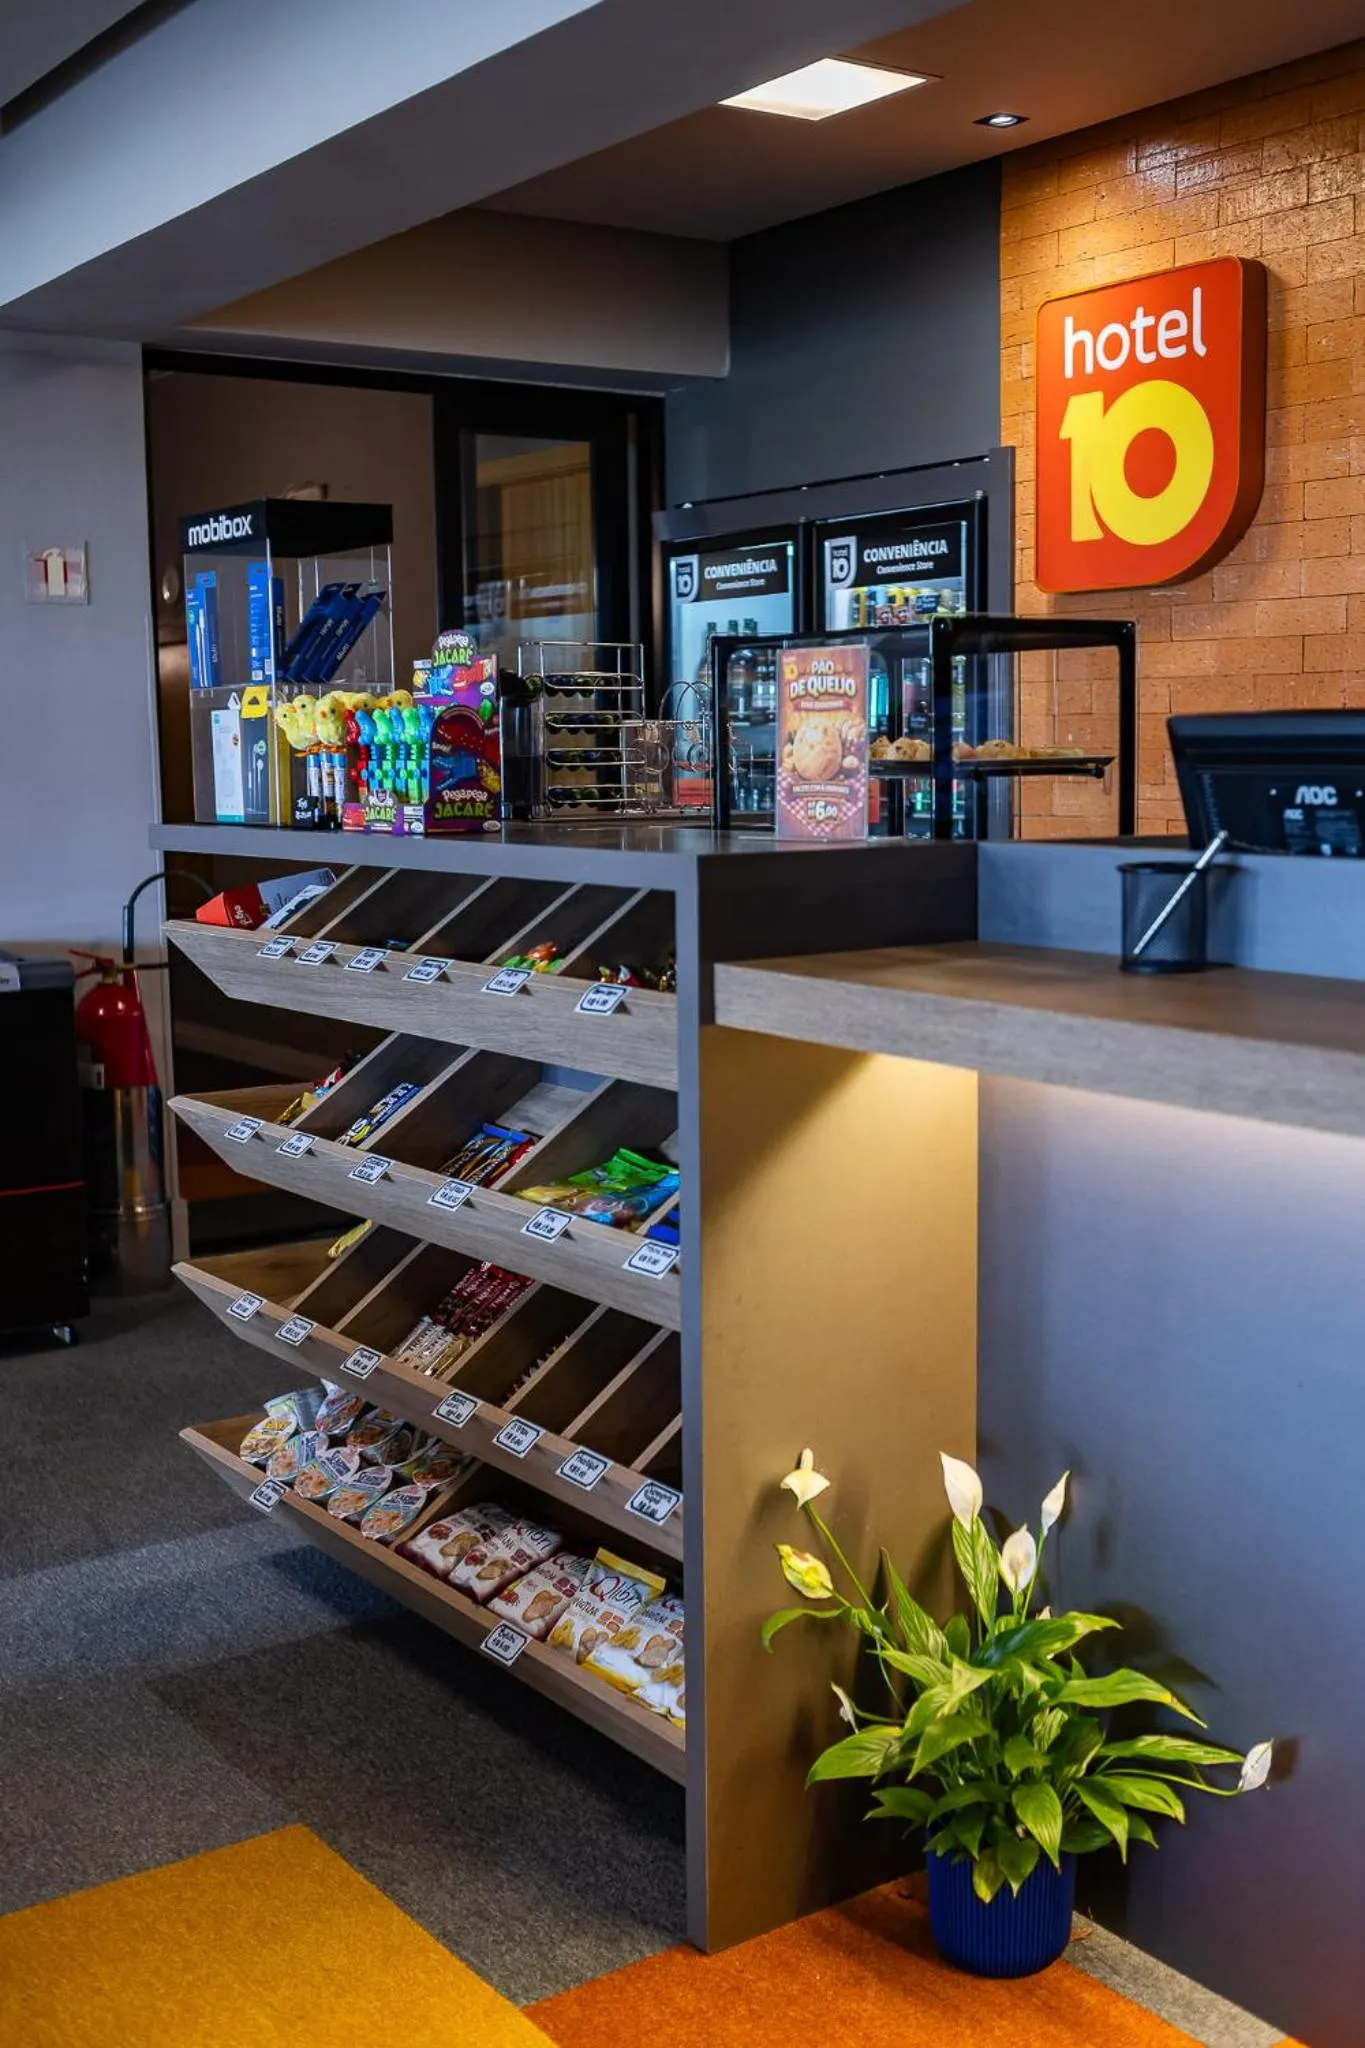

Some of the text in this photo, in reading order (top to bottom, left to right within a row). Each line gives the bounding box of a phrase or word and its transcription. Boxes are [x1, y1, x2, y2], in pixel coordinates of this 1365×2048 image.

[1064, 286, 1208, 379] hotel
[1058, 379, 1214, 546] 10
[188, 514, 253, 546] mobibox
[863, 539, 949, 562] CONVENIÊNCIA
[704, 558, 778, 579] CONVENIÊNCIA
[831, 558, 850, 579] 10
[876, 560, 934, 575] Convenience Store
[1295, 785, 1338, 806] AOC
